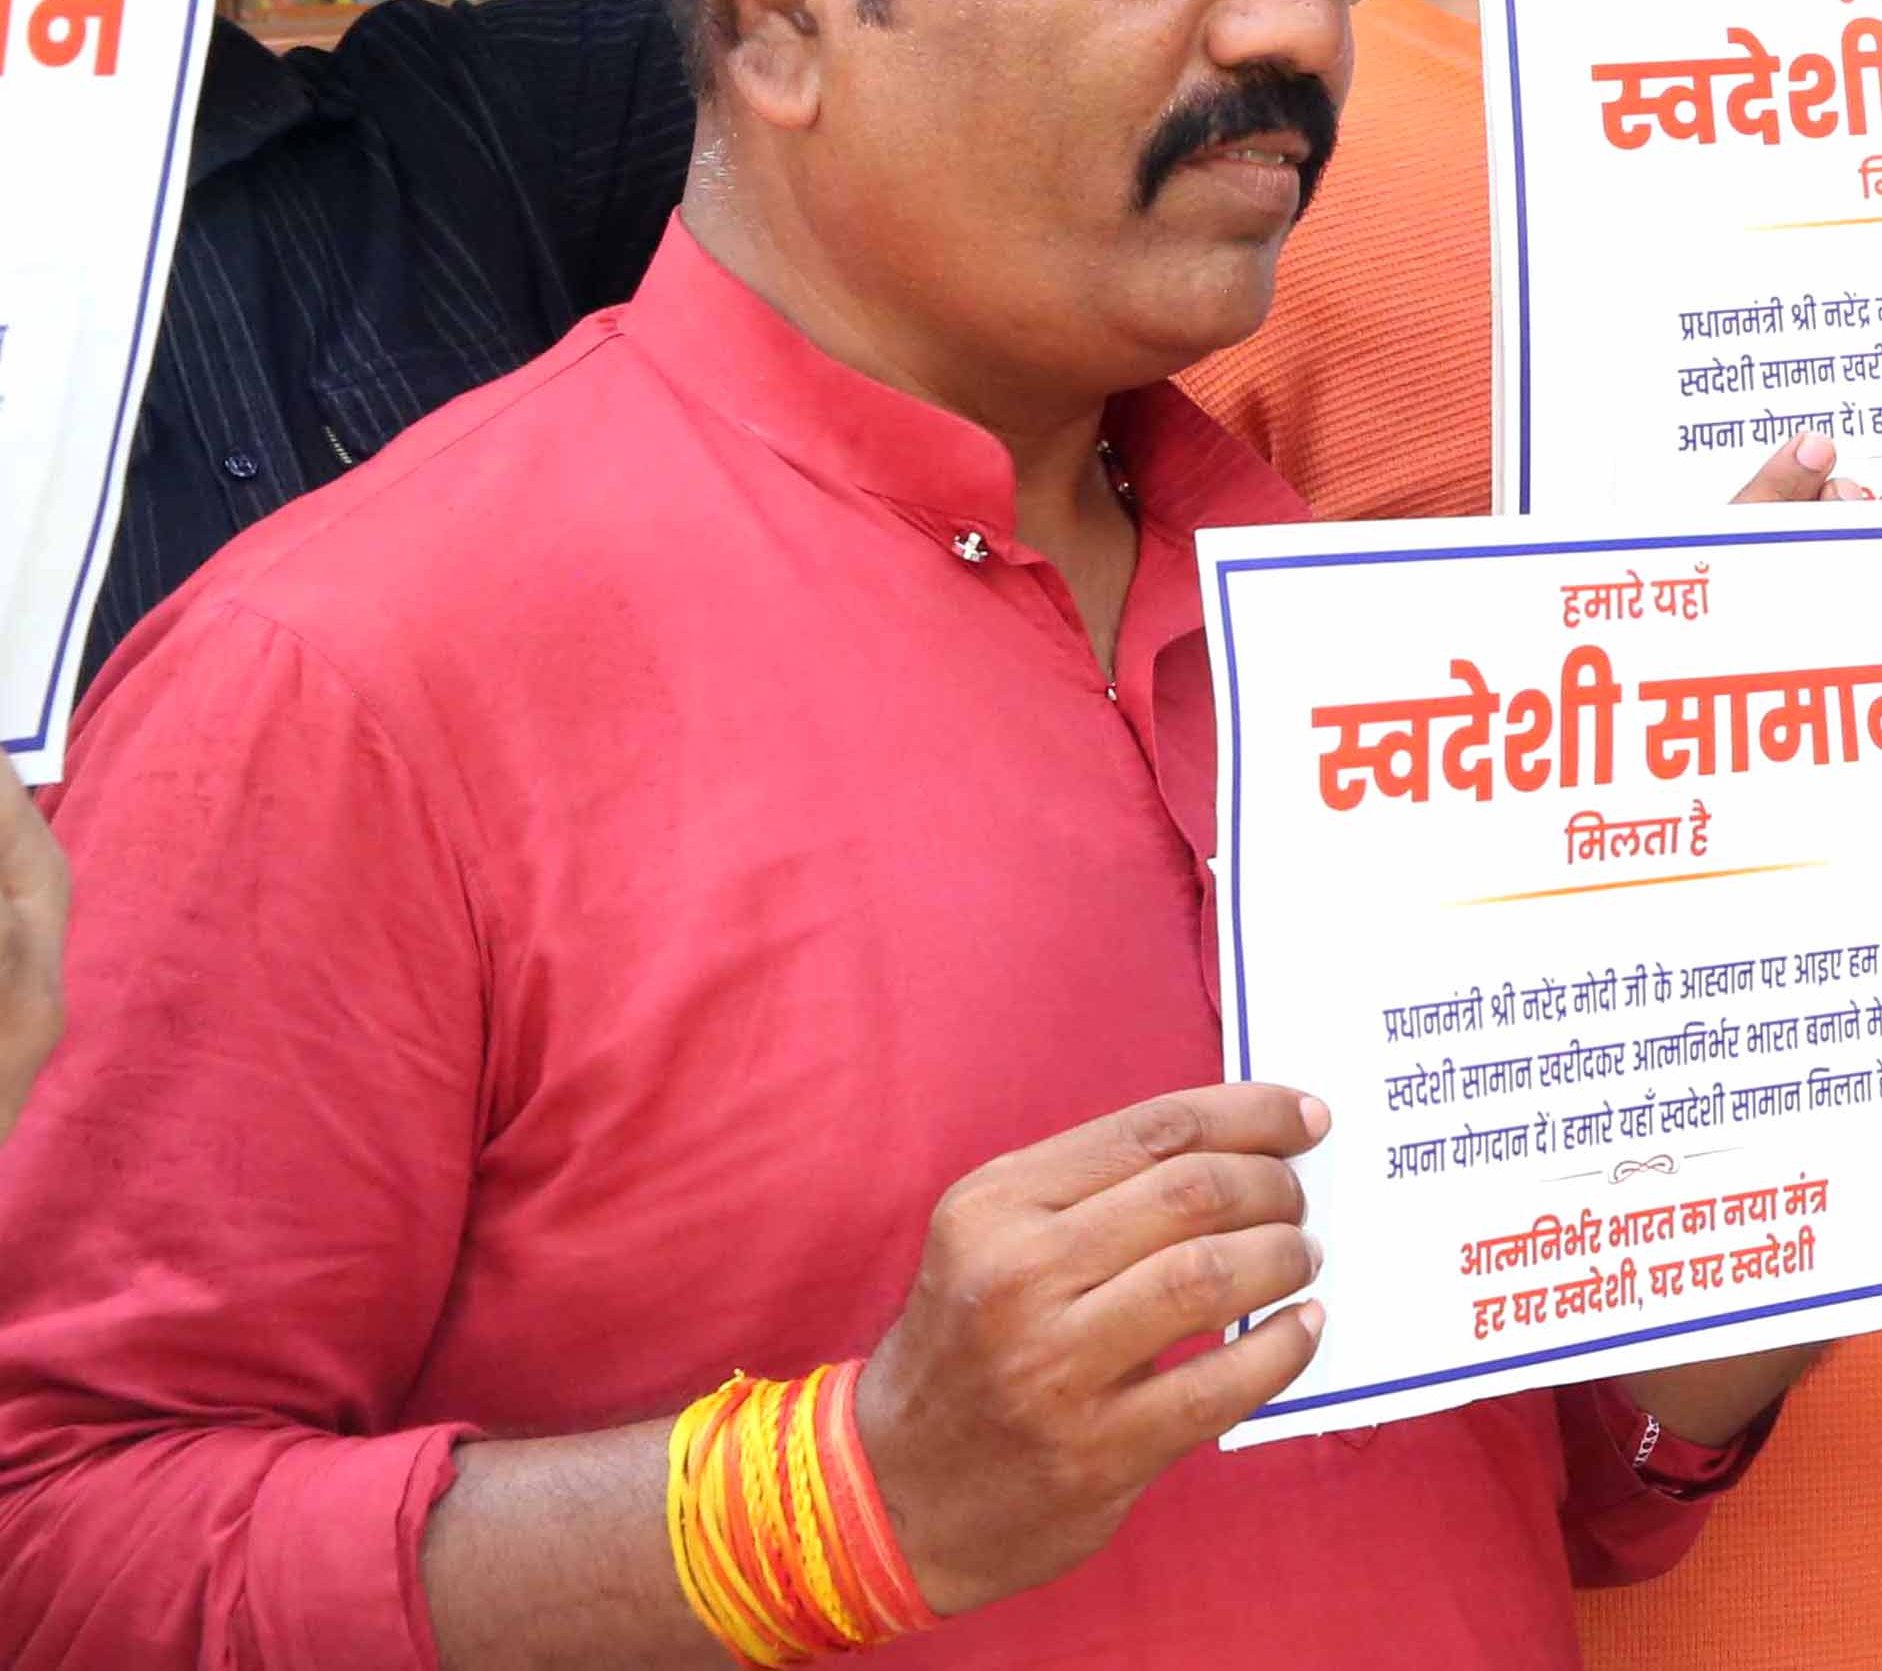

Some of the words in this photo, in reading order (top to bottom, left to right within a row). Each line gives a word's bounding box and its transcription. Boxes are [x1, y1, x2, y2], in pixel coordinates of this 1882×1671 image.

[1559, 568, 1645, 627] हमारे
[1649, 563, 1711, 619] यहाँ
[1310, 644, 1623, 813] स्वदेशी
[1563, 809, 1683, 866] मिलता
[1688, 798, 1713, 858] है
